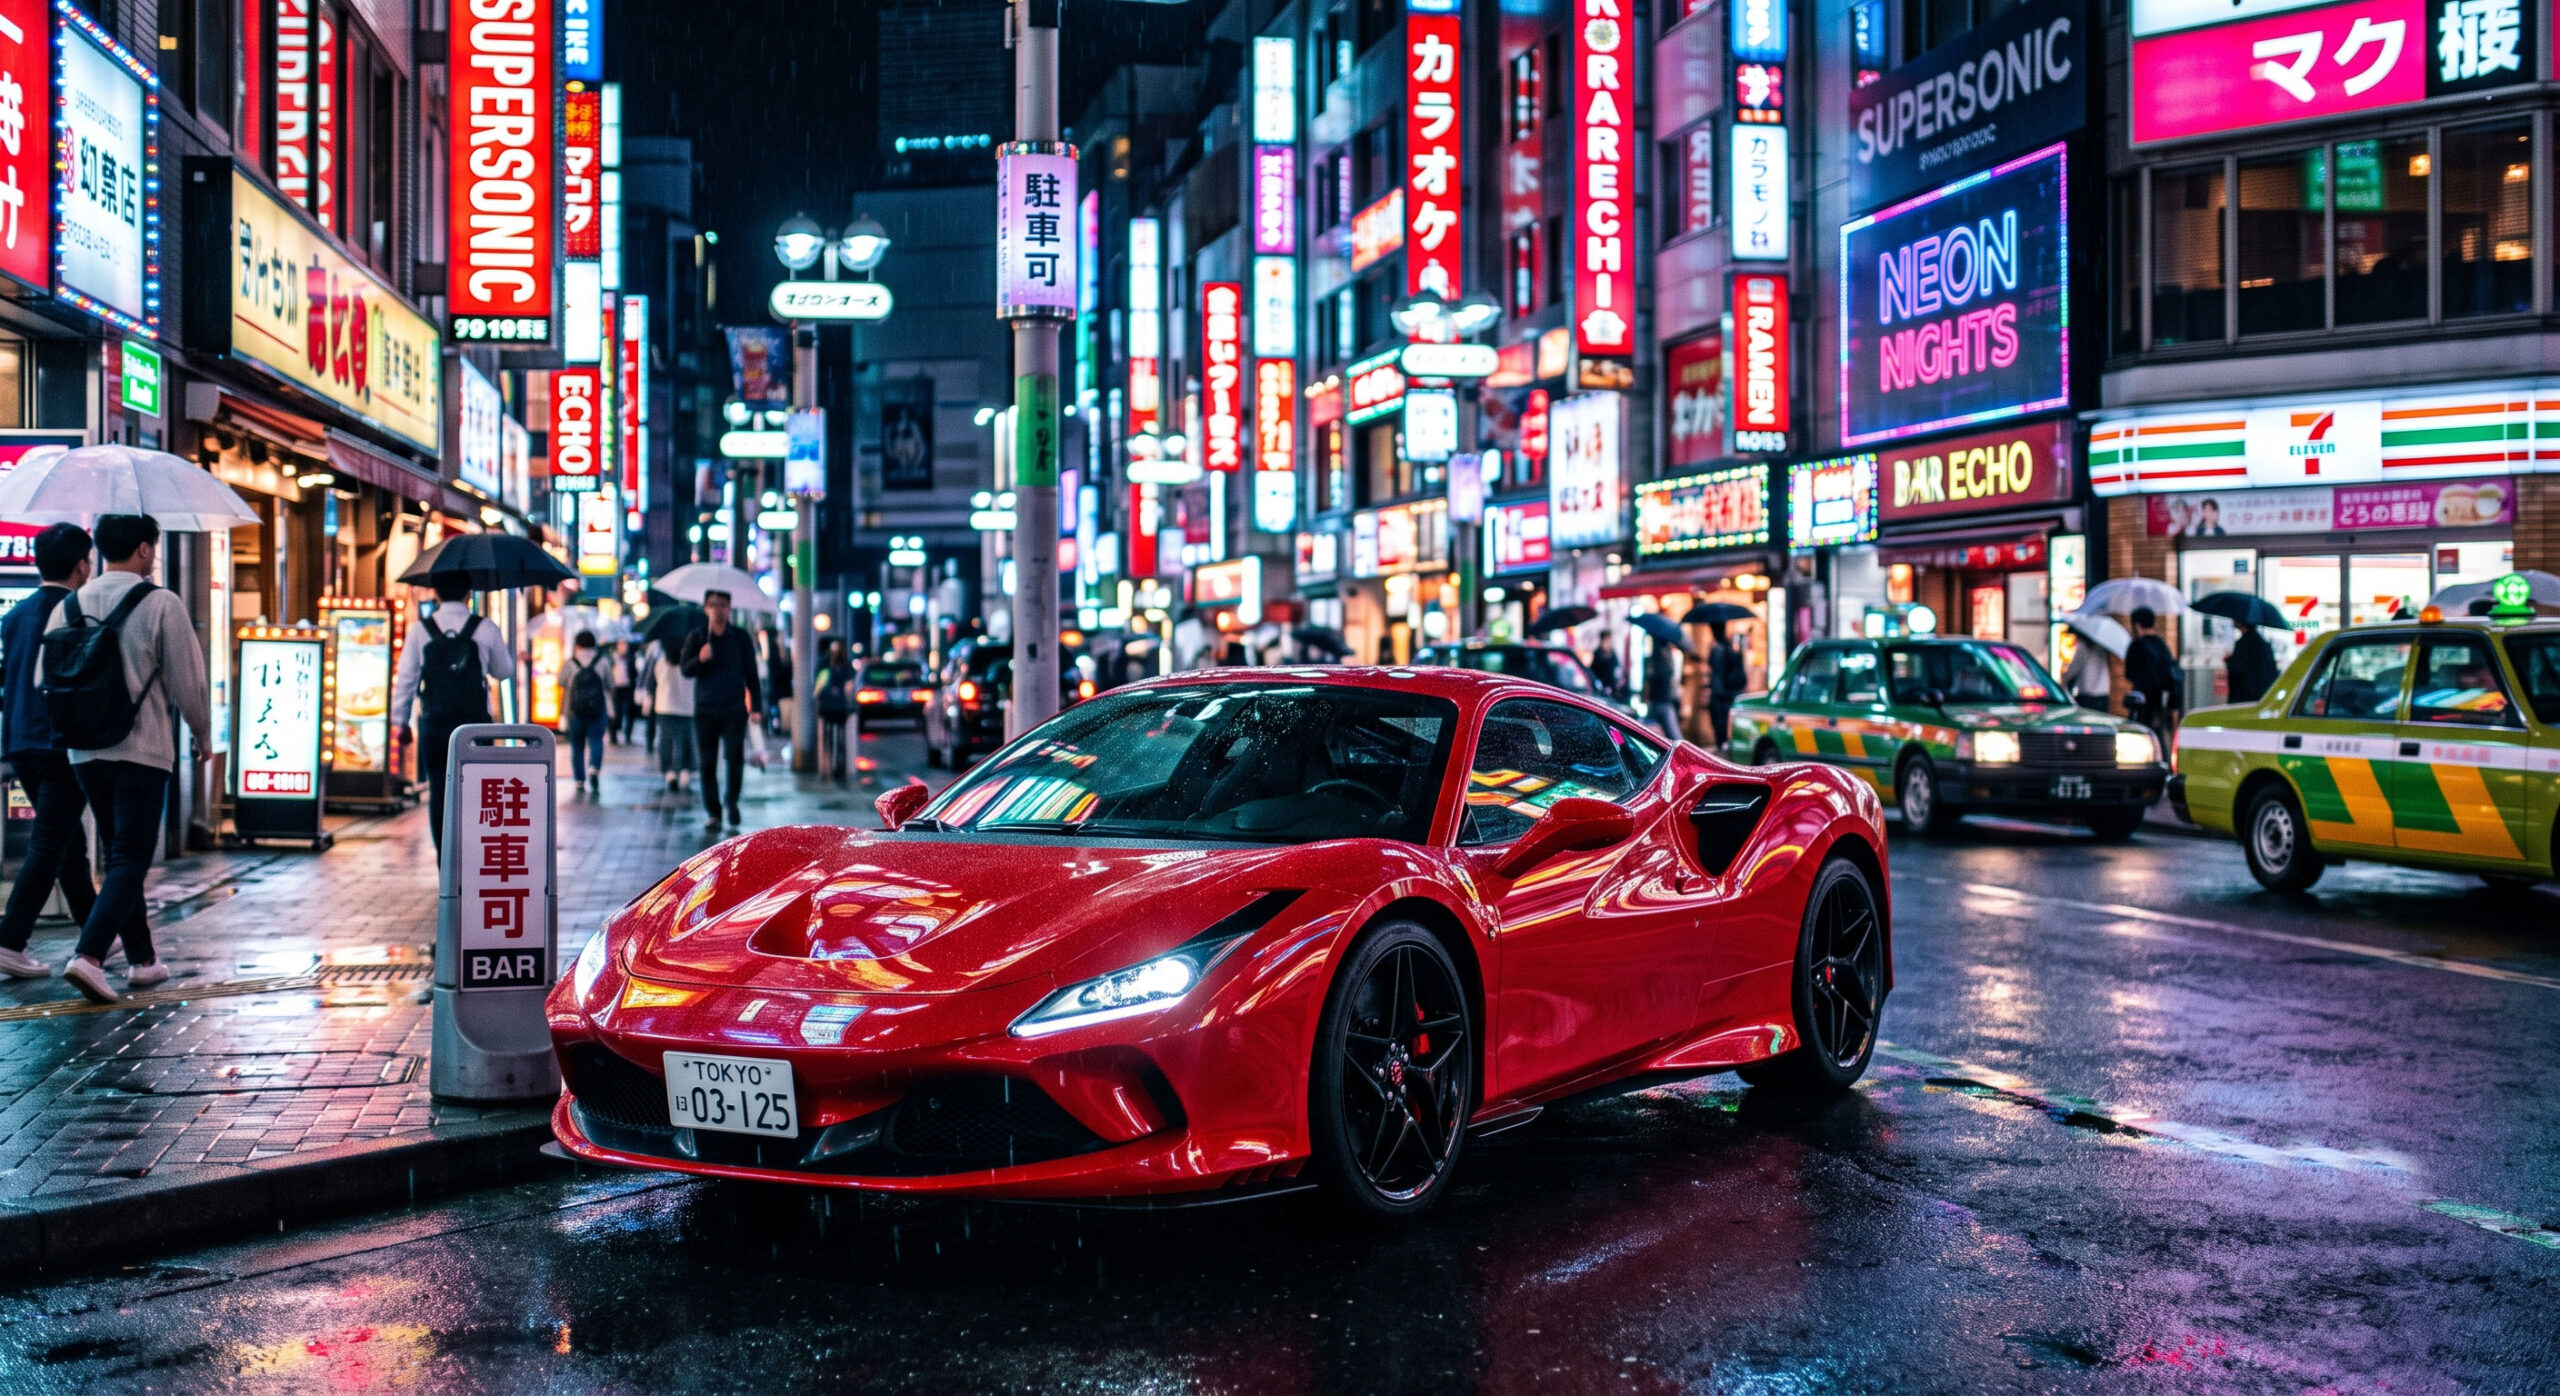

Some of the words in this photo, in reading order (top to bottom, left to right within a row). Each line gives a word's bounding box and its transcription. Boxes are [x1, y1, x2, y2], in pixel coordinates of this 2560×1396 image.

[1857, 16, 2072, 164] SUPERSONIC
[469, 0, 536, 303] SUPERSONIC
[1024, 173, 1060, 287] 駐車可
[1880, 209, 2016, 324] NEON
[1748, 305, 1775, 424] RAMEN
[1880, 302, 2019, 394] NIGHTS
[558, 375, 592, 474] ECHO
[1893, 455, 1946, 508] BAR
[1948, 440, 2033, 500] ECHO
[479, 777, 531, 938] 駐車可
[472, 955, 536, 981] BAR
[692, 1087, 790, 1131] 03-125
[693, 1061, 762, 1086] TOKYO
